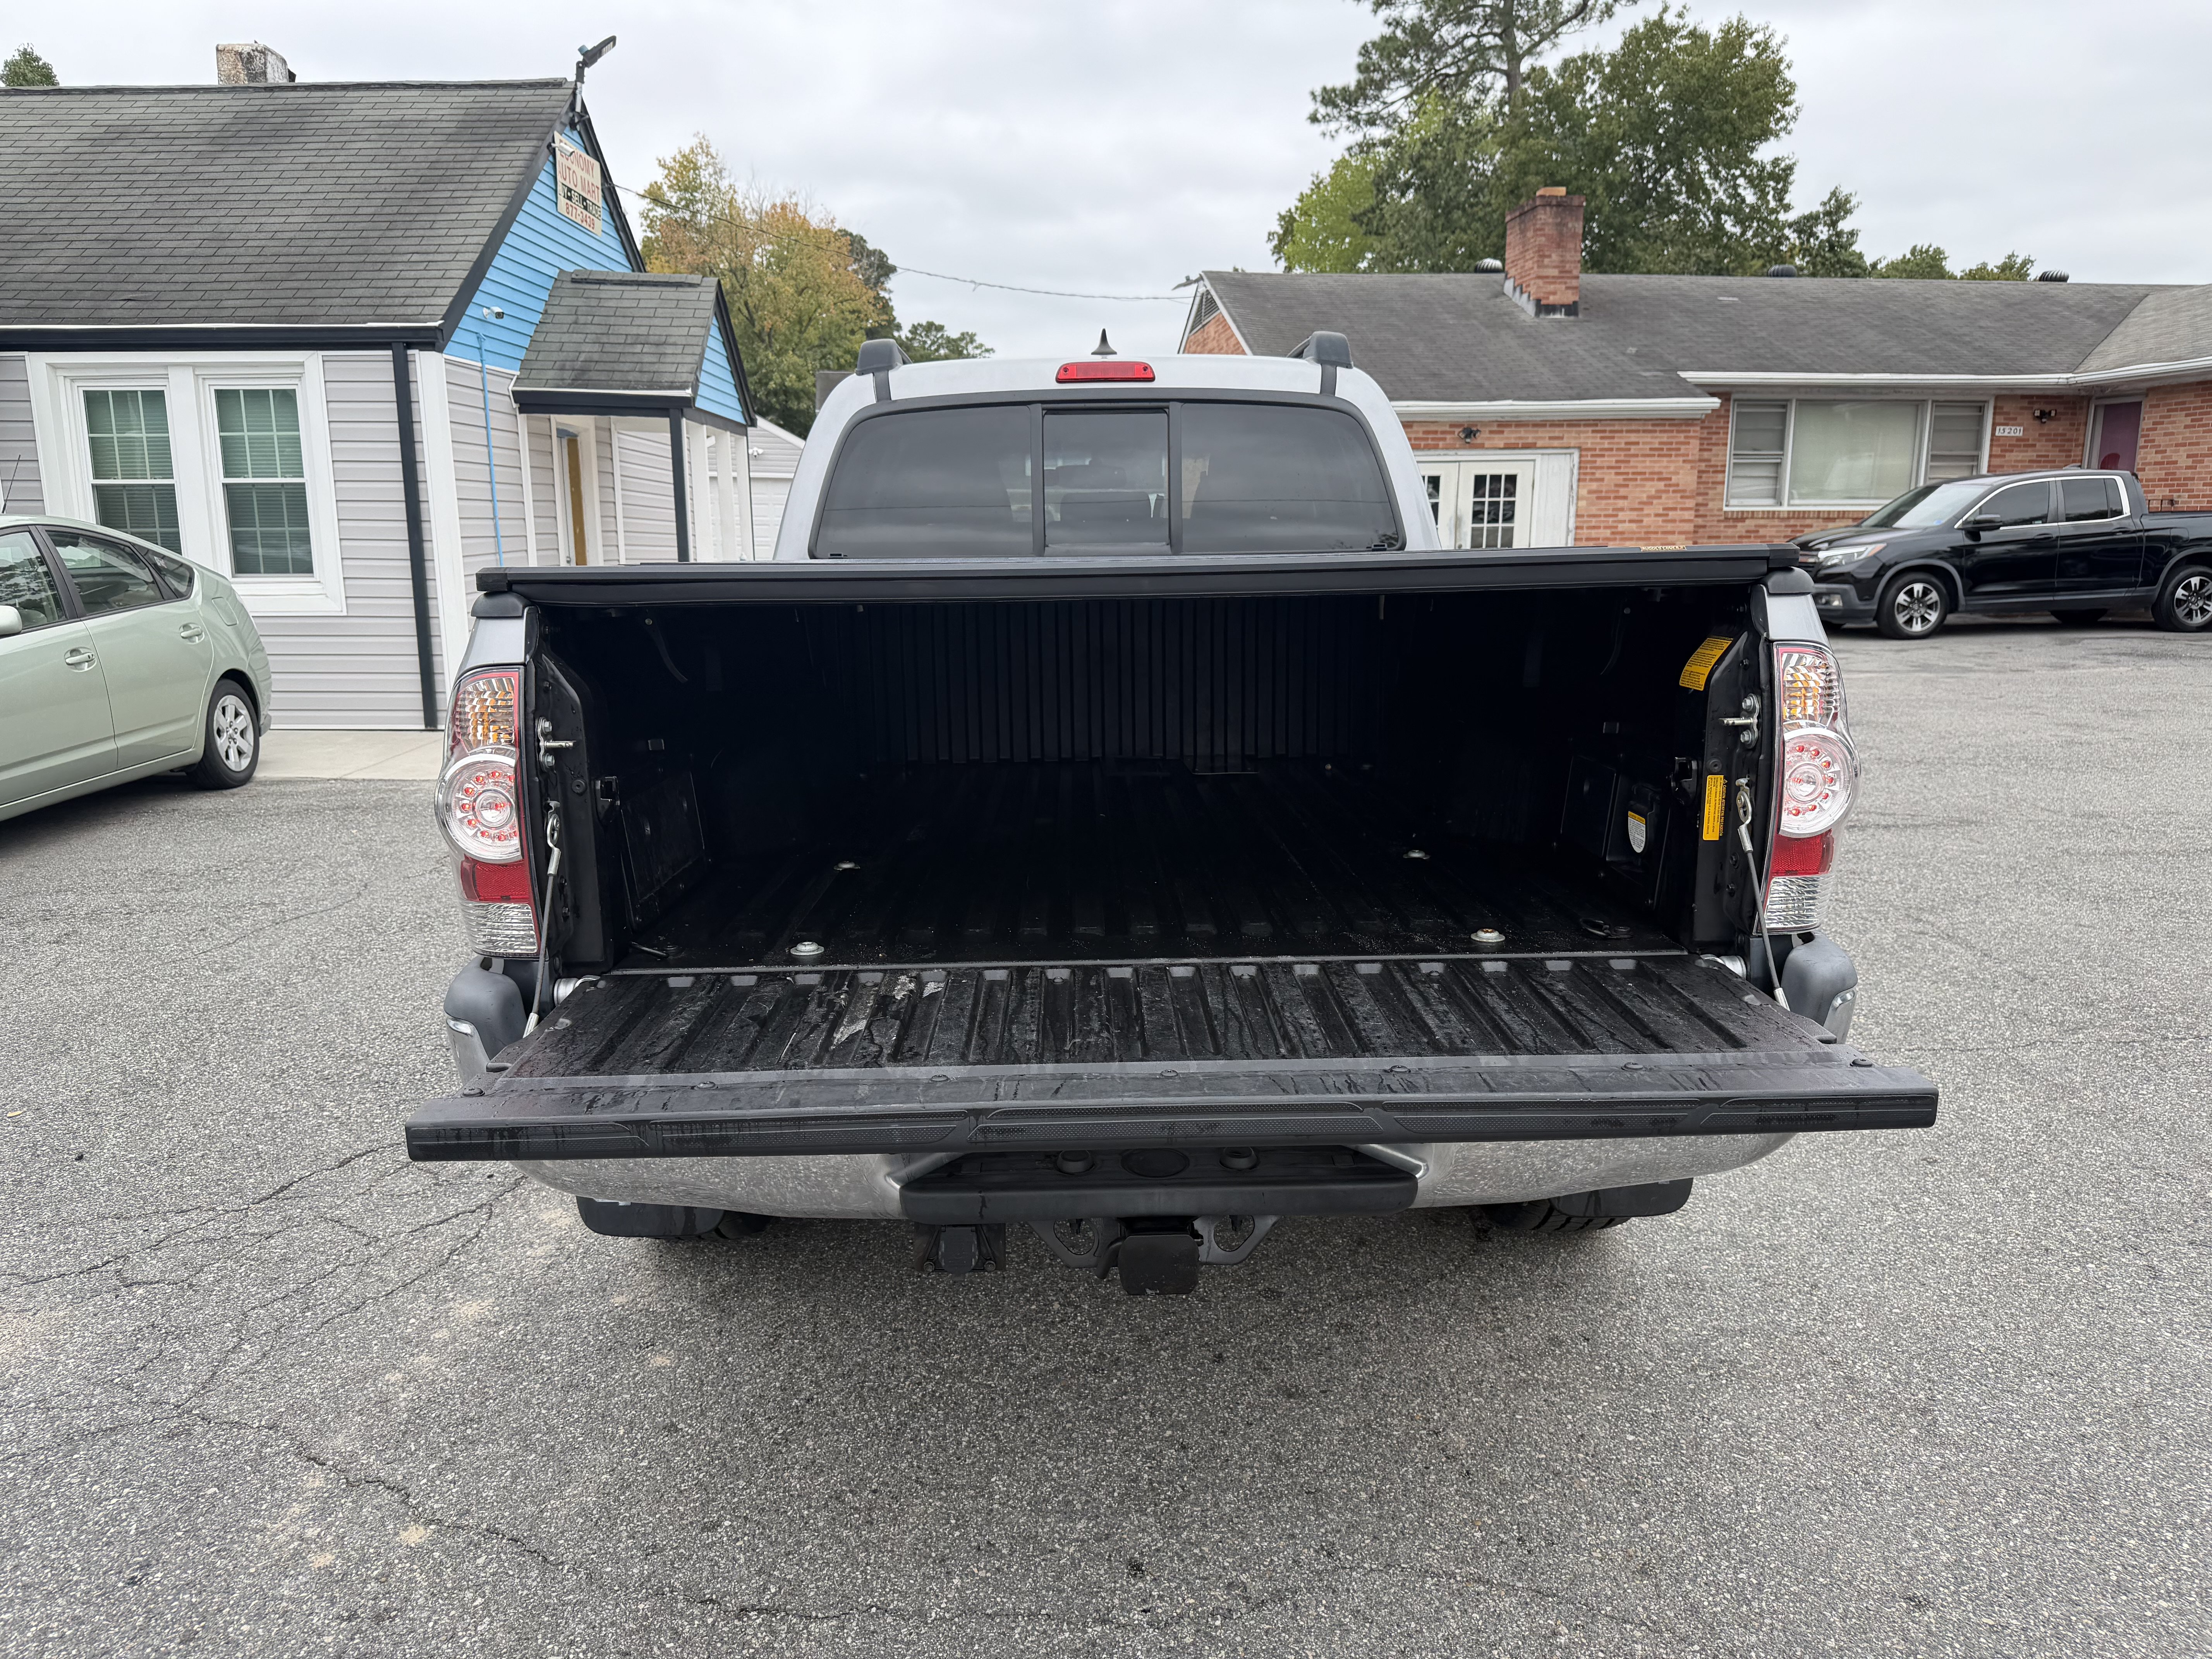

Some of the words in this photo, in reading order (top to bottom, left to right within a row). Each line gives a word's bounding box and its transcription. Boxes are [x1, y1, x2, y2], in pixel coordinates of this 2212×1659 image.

[558, 160, 577, 188] AUTO
[580, 175, 599, 203] MART
[565, 202, 595, 230] 877-3439
[571, 190, 584, 208] SELL
[586, 199, 601, 220] TRADE
